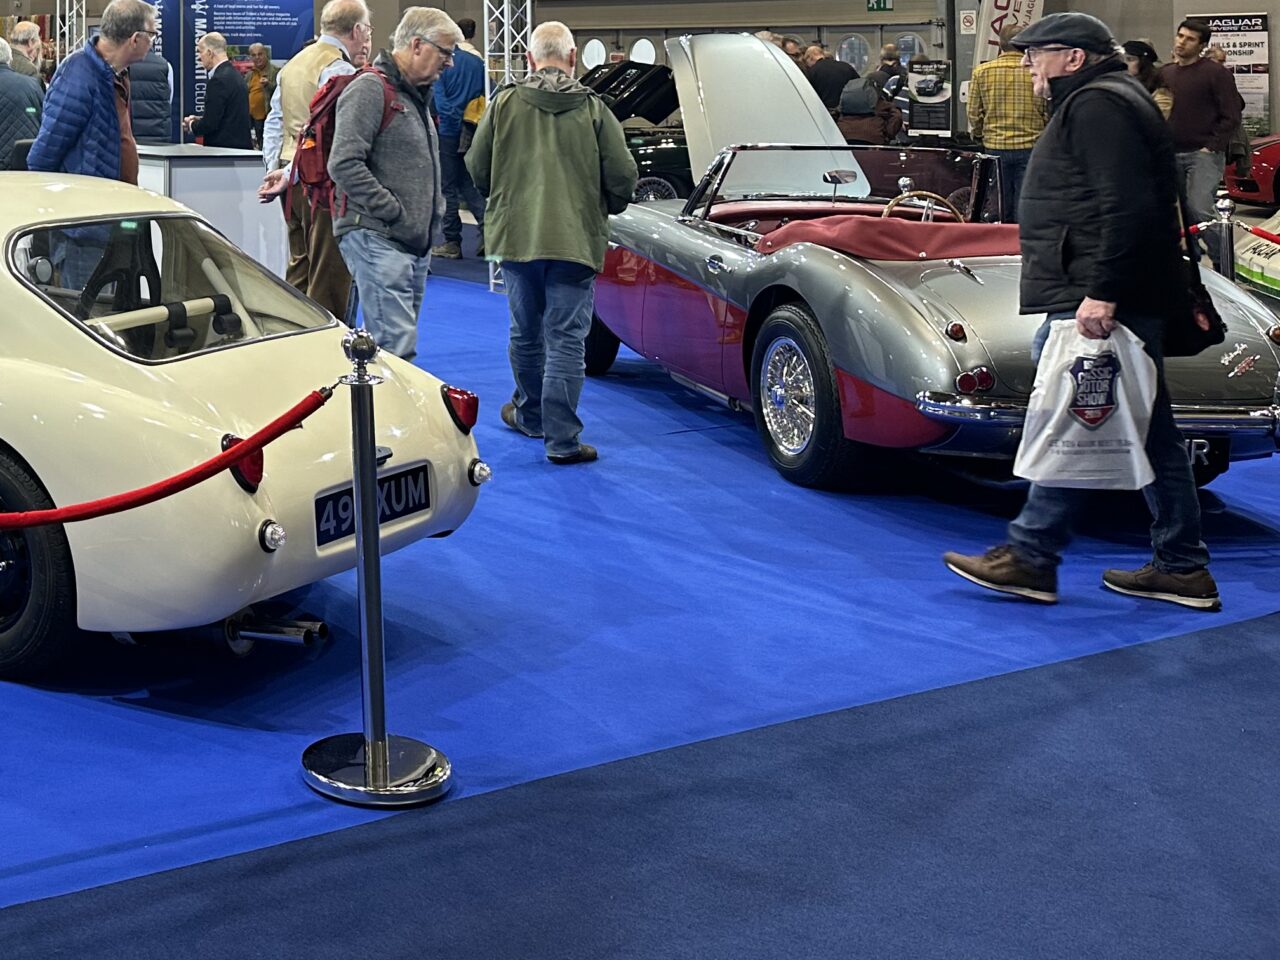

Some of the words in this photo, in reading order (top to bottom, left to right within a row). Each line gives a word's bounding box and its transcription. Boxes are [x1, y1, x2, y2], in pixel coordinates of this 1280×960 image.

[1207, 18, 1263, 26] JAGUAR
[194, 82, 207, 113] CLUB
[1076, 392, 1107, 406] SHOW
[377, 472, 426, 516] XUM
